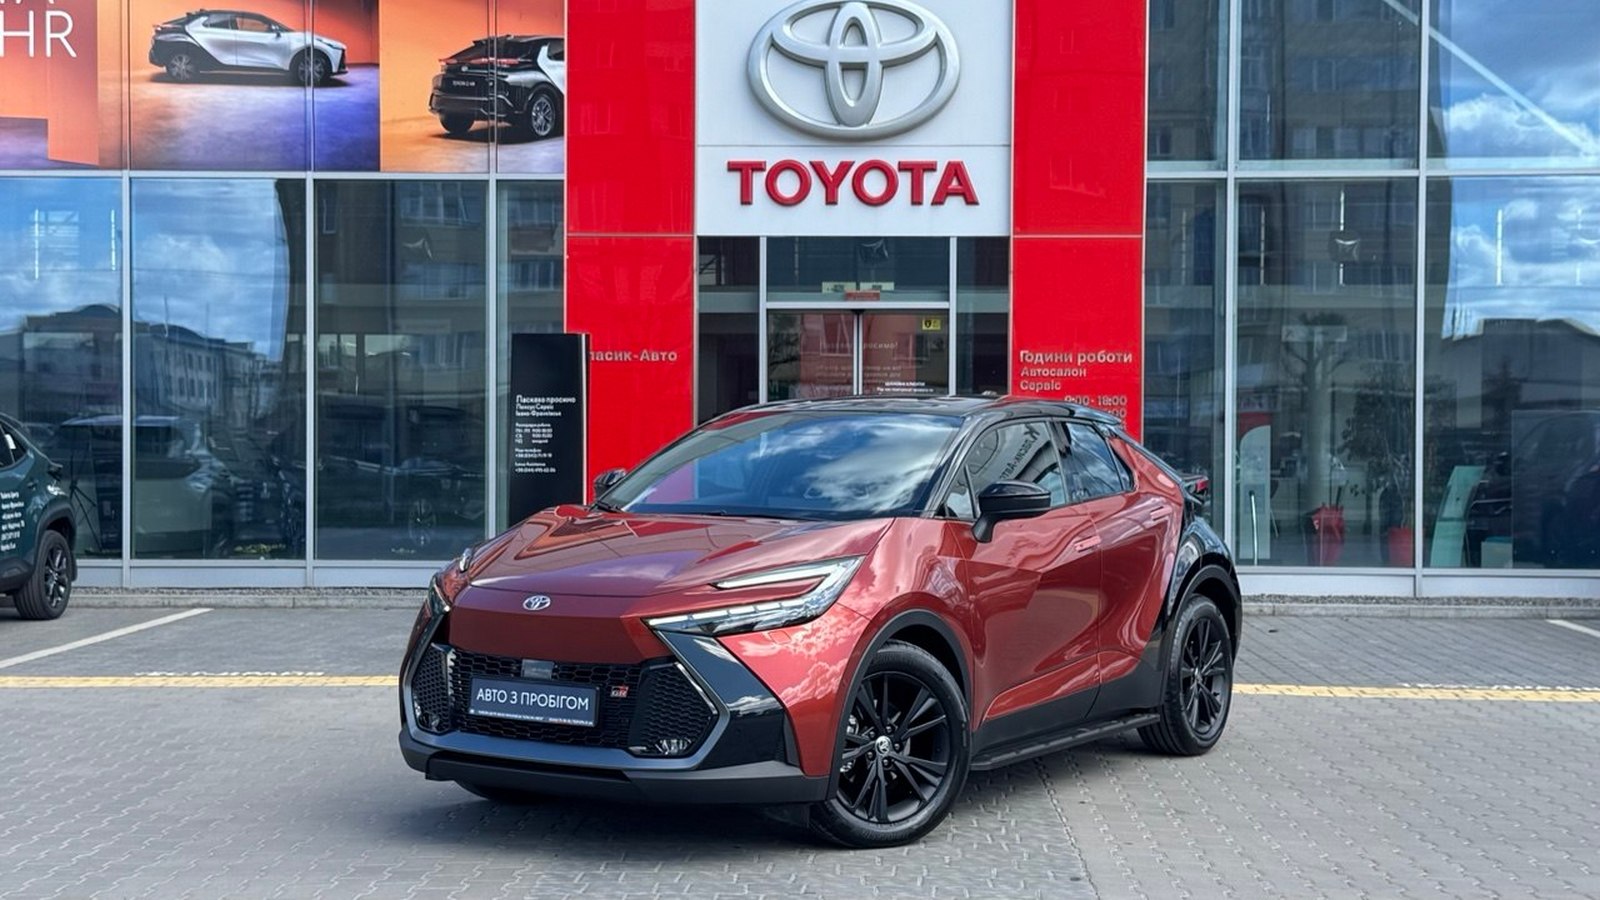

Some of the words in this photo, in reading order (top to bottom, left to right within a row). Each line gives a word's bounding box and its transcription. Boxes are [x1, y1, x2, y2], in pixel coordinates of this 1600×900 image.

[727, 159, 980, 207] TOYOTA
[1020, 350, 1073, 365] Години
[1077, 350, 1133, 366] роботи
[1020, 366, 1087, 377] Автосалон
[1020, 380, 1061, 393] Сервіс
[476, 688, 507, 703] АВТО
[510, 691, 518, 704] З
[520, 692, 589, 711] ПРОБІГОМ
